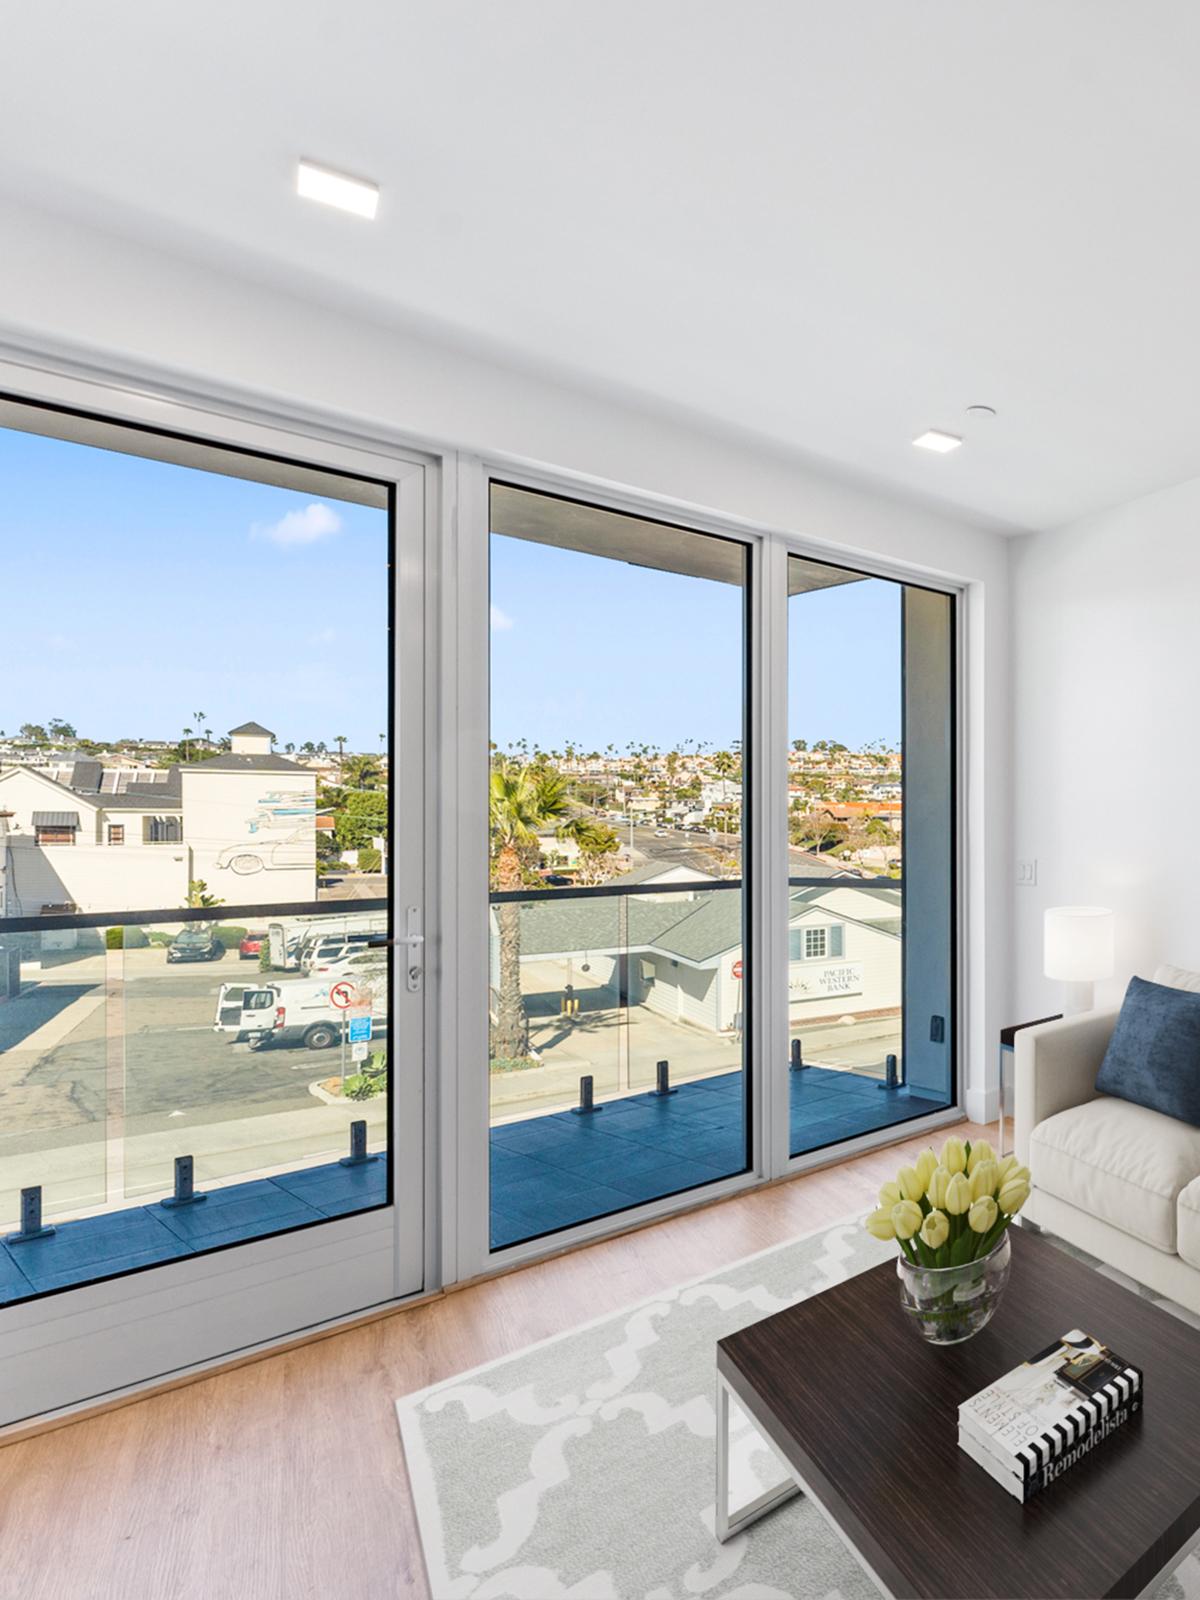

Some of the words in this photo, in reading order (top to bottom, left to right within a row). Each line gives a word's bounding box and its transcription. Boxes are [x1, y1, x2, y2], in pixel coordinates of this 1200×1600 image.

[819, 974, 860, 985] WESTERN
[823, 968, 854, 978] PACIFIC
[827, 983, 850, 992] BANK
[982, 1389, 1022, 1422] STYLE
[968, 1398, 1028, 1447] ELEMENTS
[1016, 1420, 1039, 1437] OF
[1043, 1408, 1128, 1489] Remodelista
